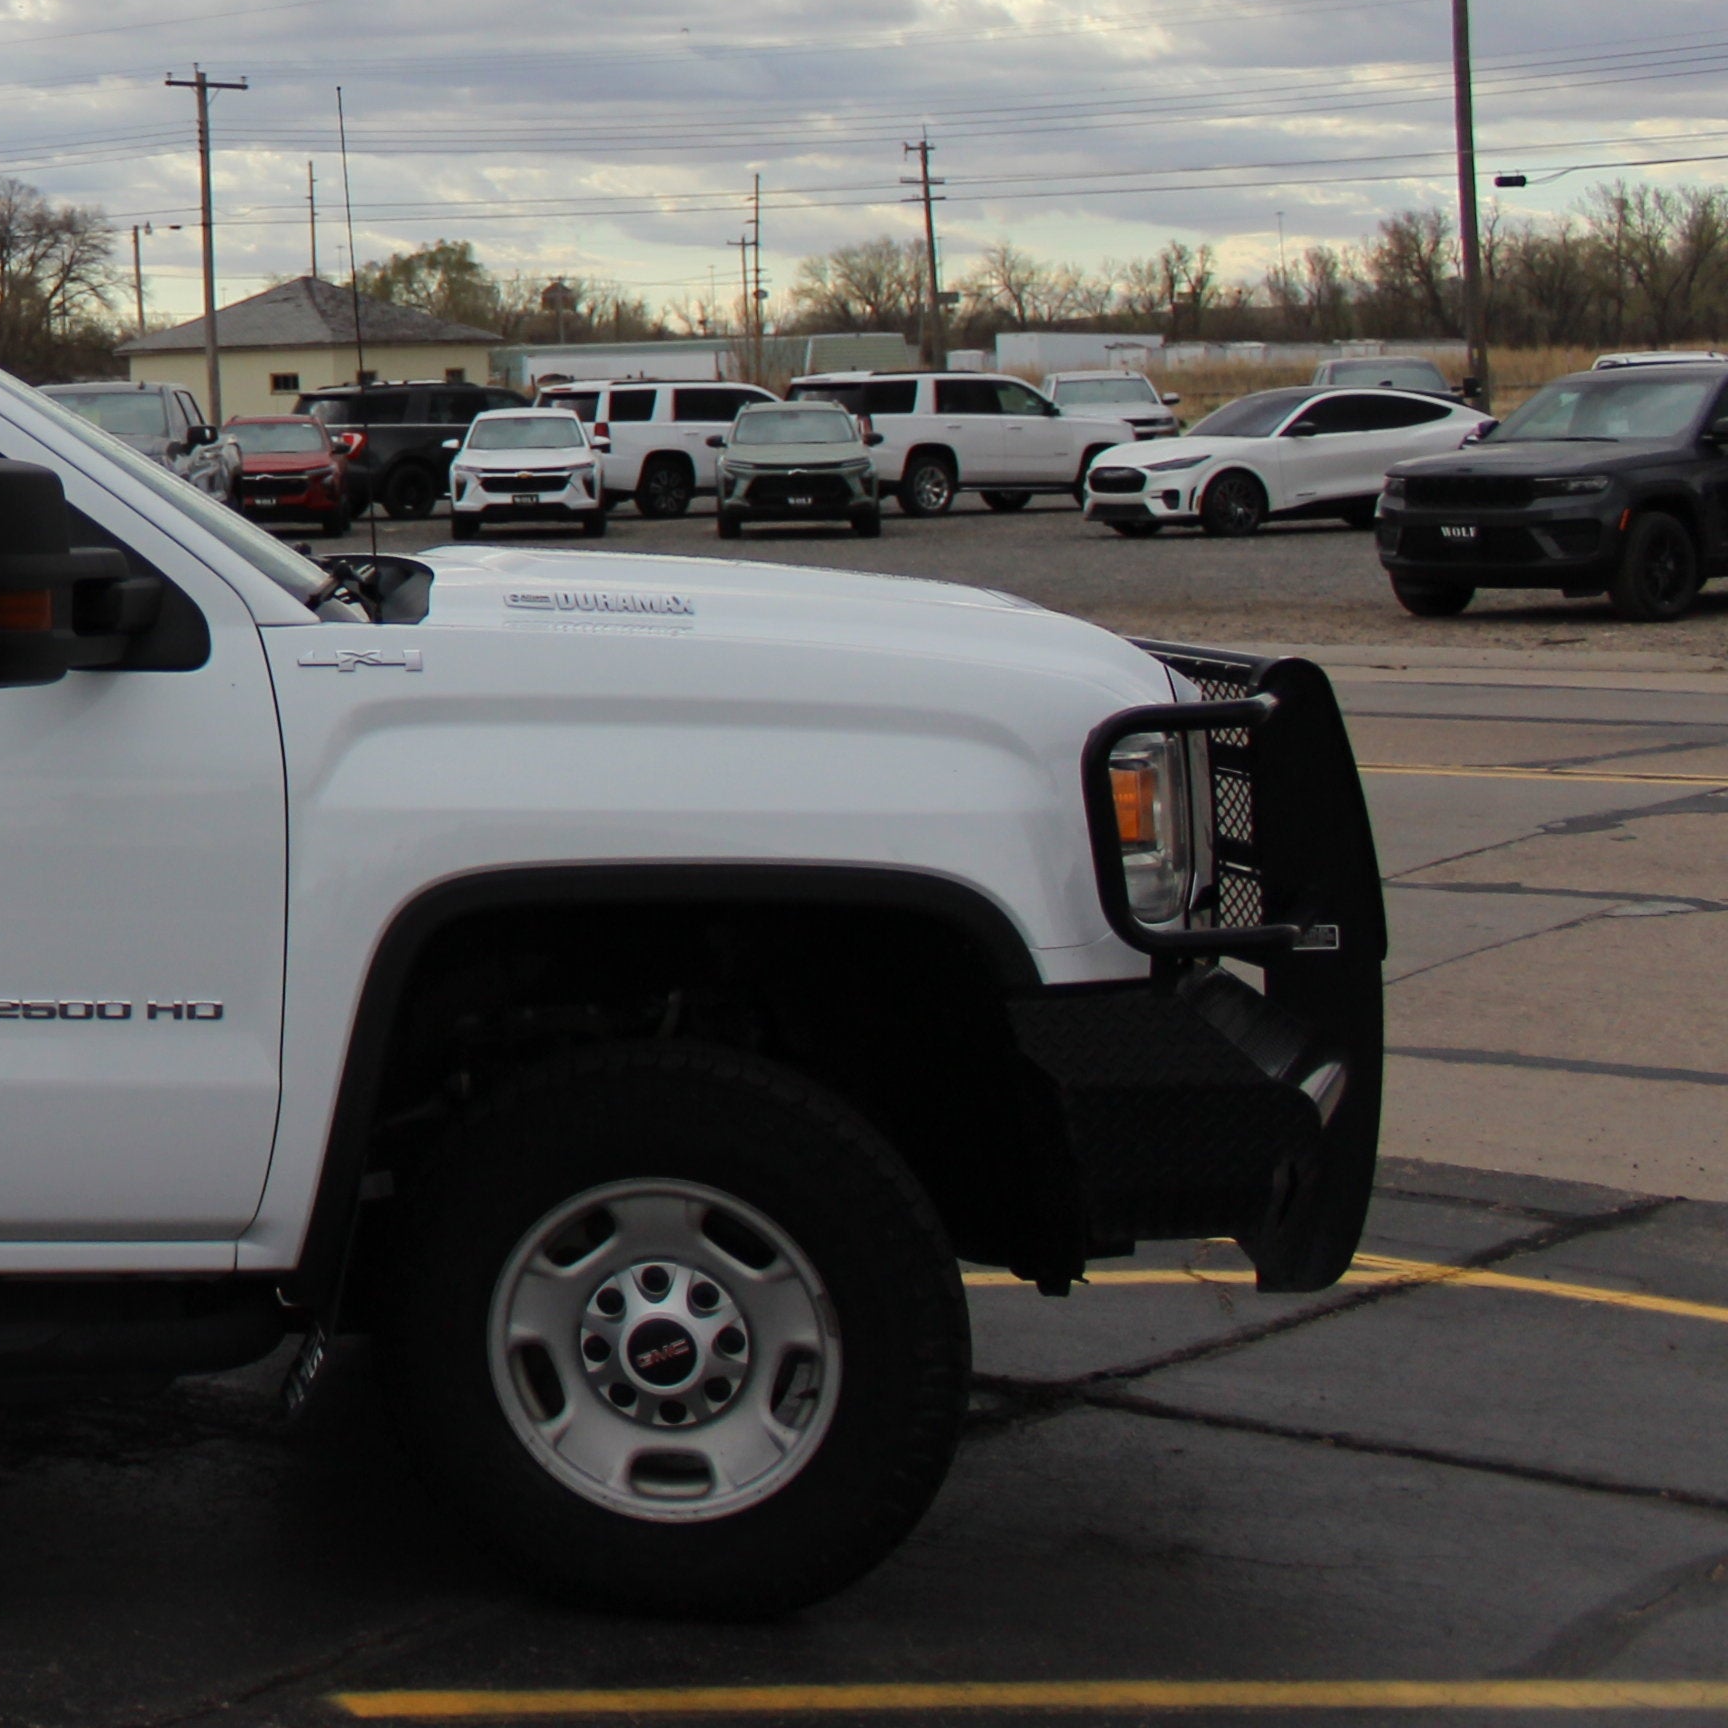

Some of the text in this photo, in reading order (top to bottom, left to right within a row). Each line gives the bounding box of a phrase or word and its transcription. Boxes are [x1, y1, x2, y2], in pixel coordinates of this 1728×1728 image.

[1440, 526, 1477, 537] WOLF
[555, 592, 695, 615] DURAMAX
[147, 1000, 223, 1019] HD
[636, 1339, 690, 1369] GMC
